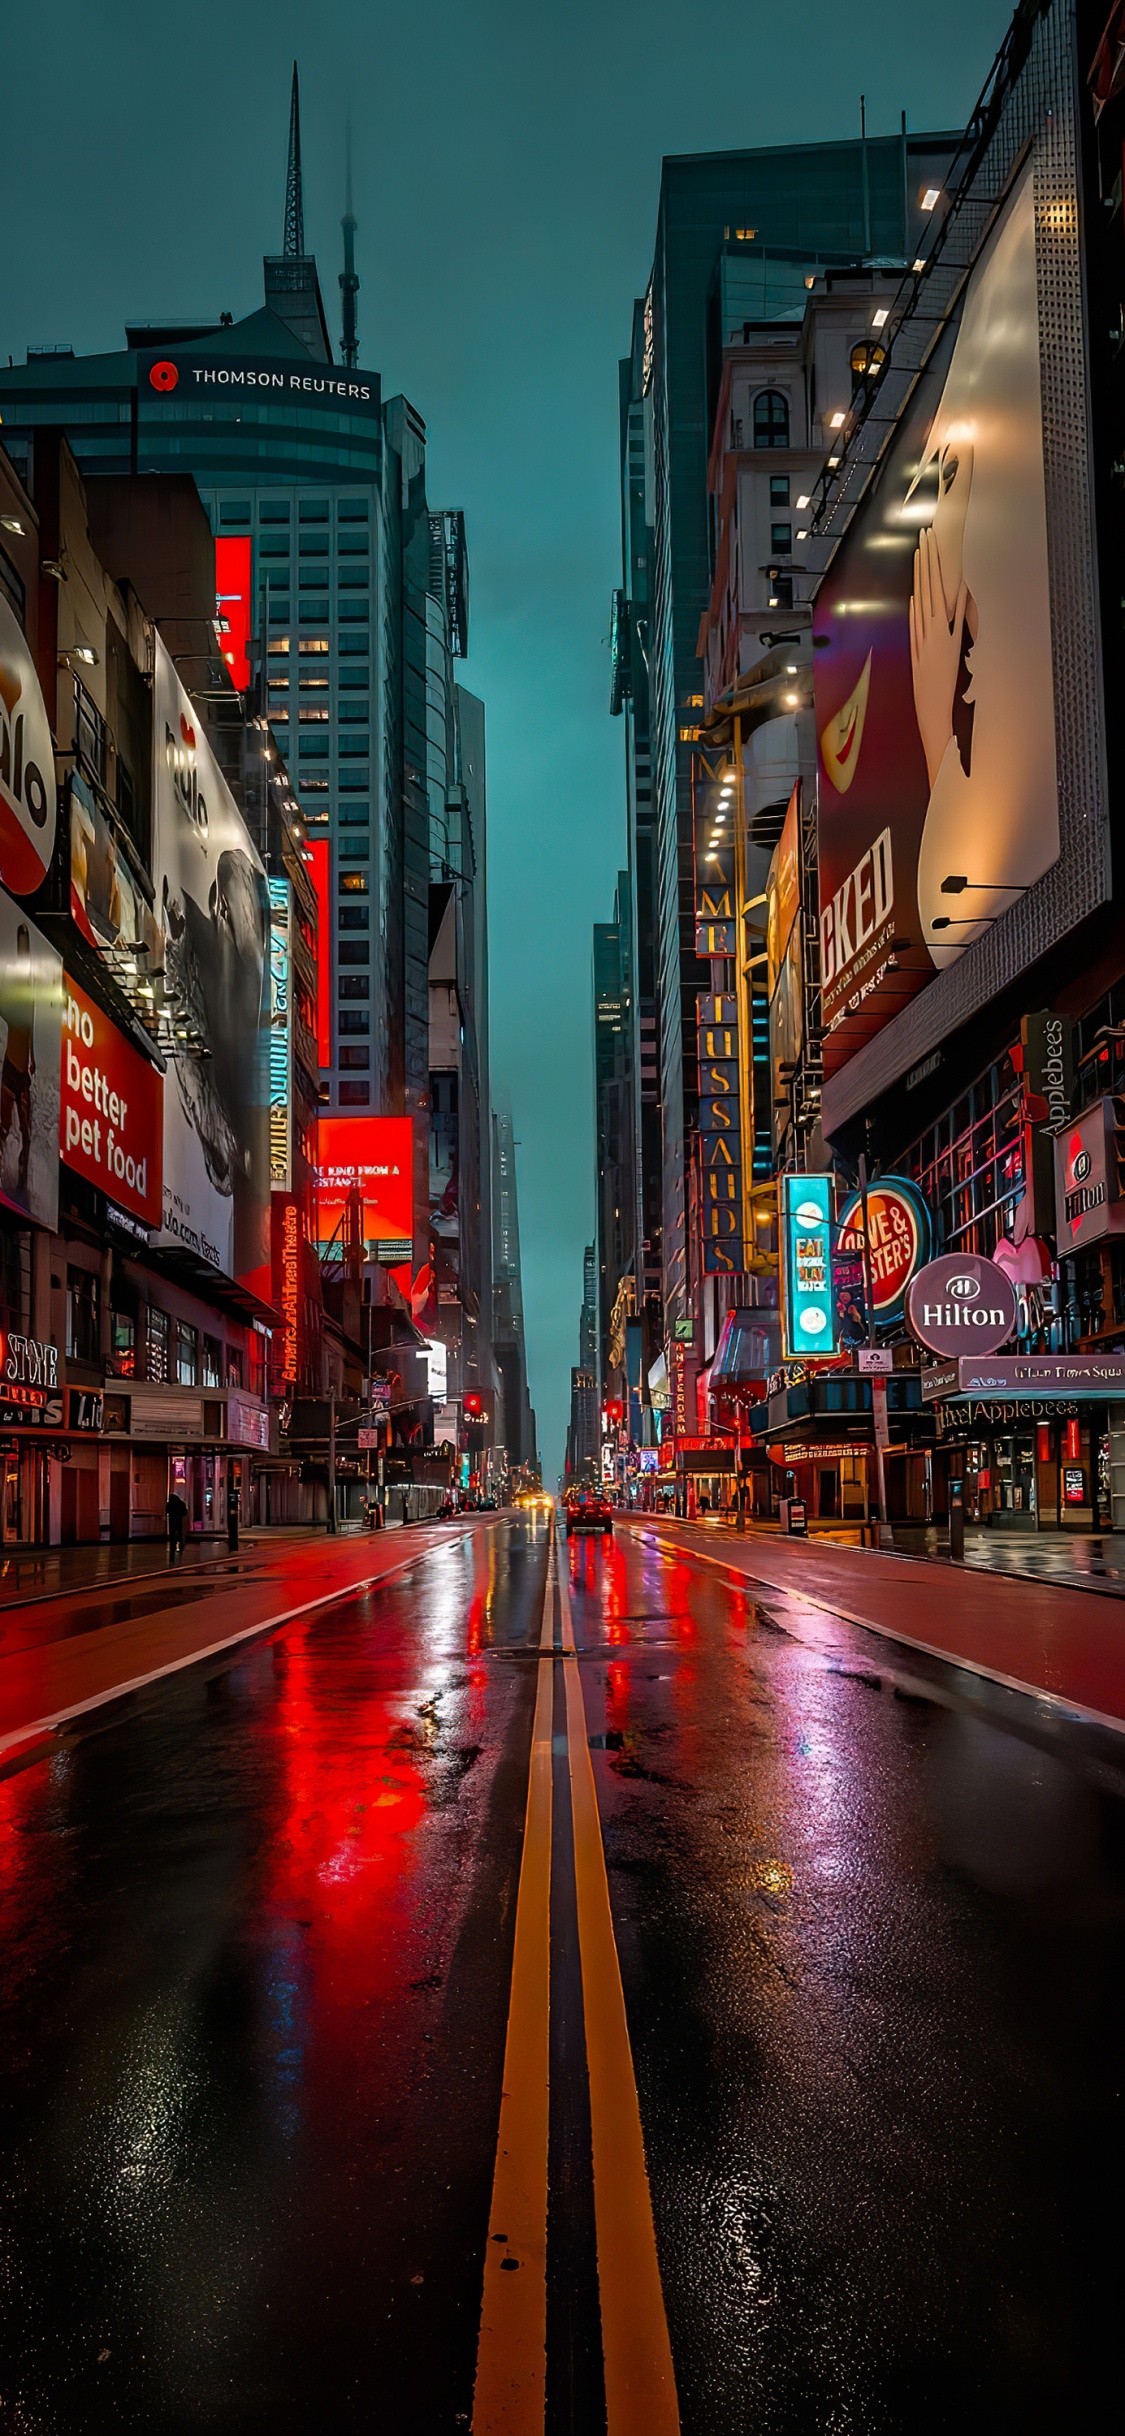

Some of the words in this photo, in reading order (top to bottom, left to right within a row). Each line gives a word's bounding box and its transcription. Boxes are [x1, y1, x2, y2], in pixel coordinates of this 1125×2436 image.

[192, 369, 284, 388] THOMSON
[289, 375, 371, 400] REUTERS
[67, 994, 94, 1048] no
[66, 1038, 128, 1131] better
[1039, 1019, 1071, 1137] Applebee's
[65, 1104, 101, 1163] pet
[106, 1127, 148, 1199] food
[704, 994, 736, 1272] TUSSAUDS
[889, 1206, 909, 1234] &
[923, 1302, 1006, 1327] Hilton
